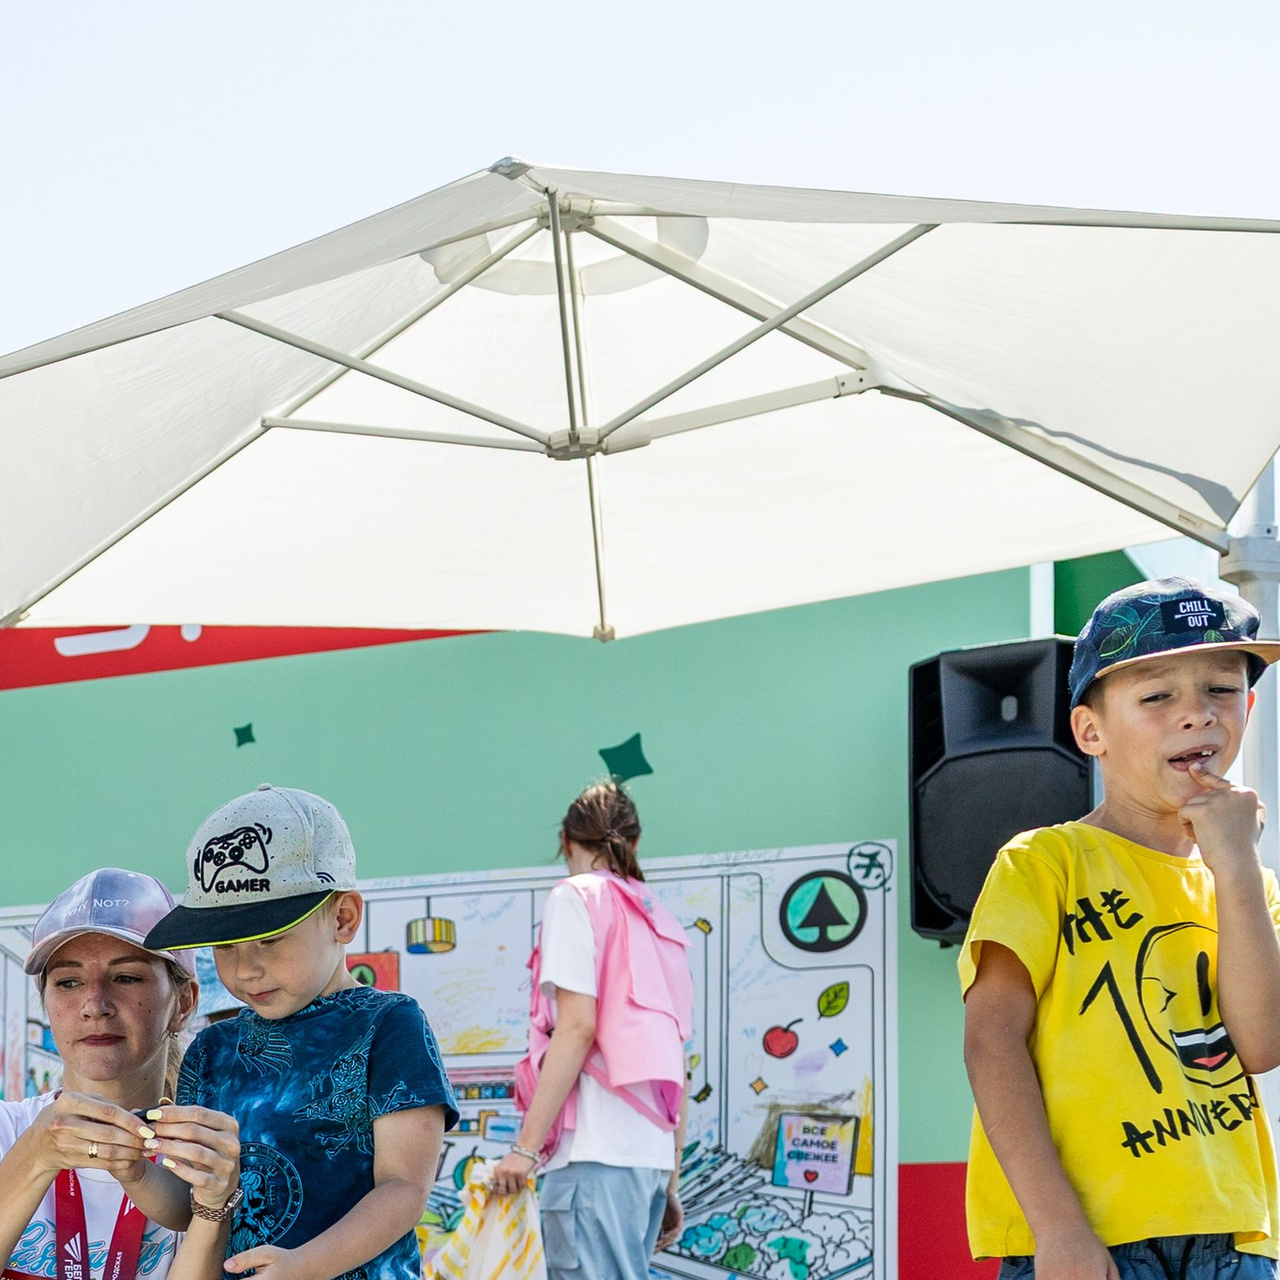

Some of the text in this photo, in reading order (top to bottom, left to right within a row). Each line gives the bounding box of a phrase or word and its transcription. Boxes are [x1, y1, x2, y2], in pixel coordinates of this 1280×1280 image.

[1179, 600, 1212, 613] CHILL
[1187, 615, 1209, 628] OUT
[215, 878, 270, 893] GAMER
[67, 898, 130, 917] WHY NOT?
[1063, 888, 1144, 956] THE
[803, 1124, 827, 1136] ВСЕ
[791, 1138, 838, 1150] САМОЕ
[787, 1149, 839, 1162] СВЕЖЕЕ
